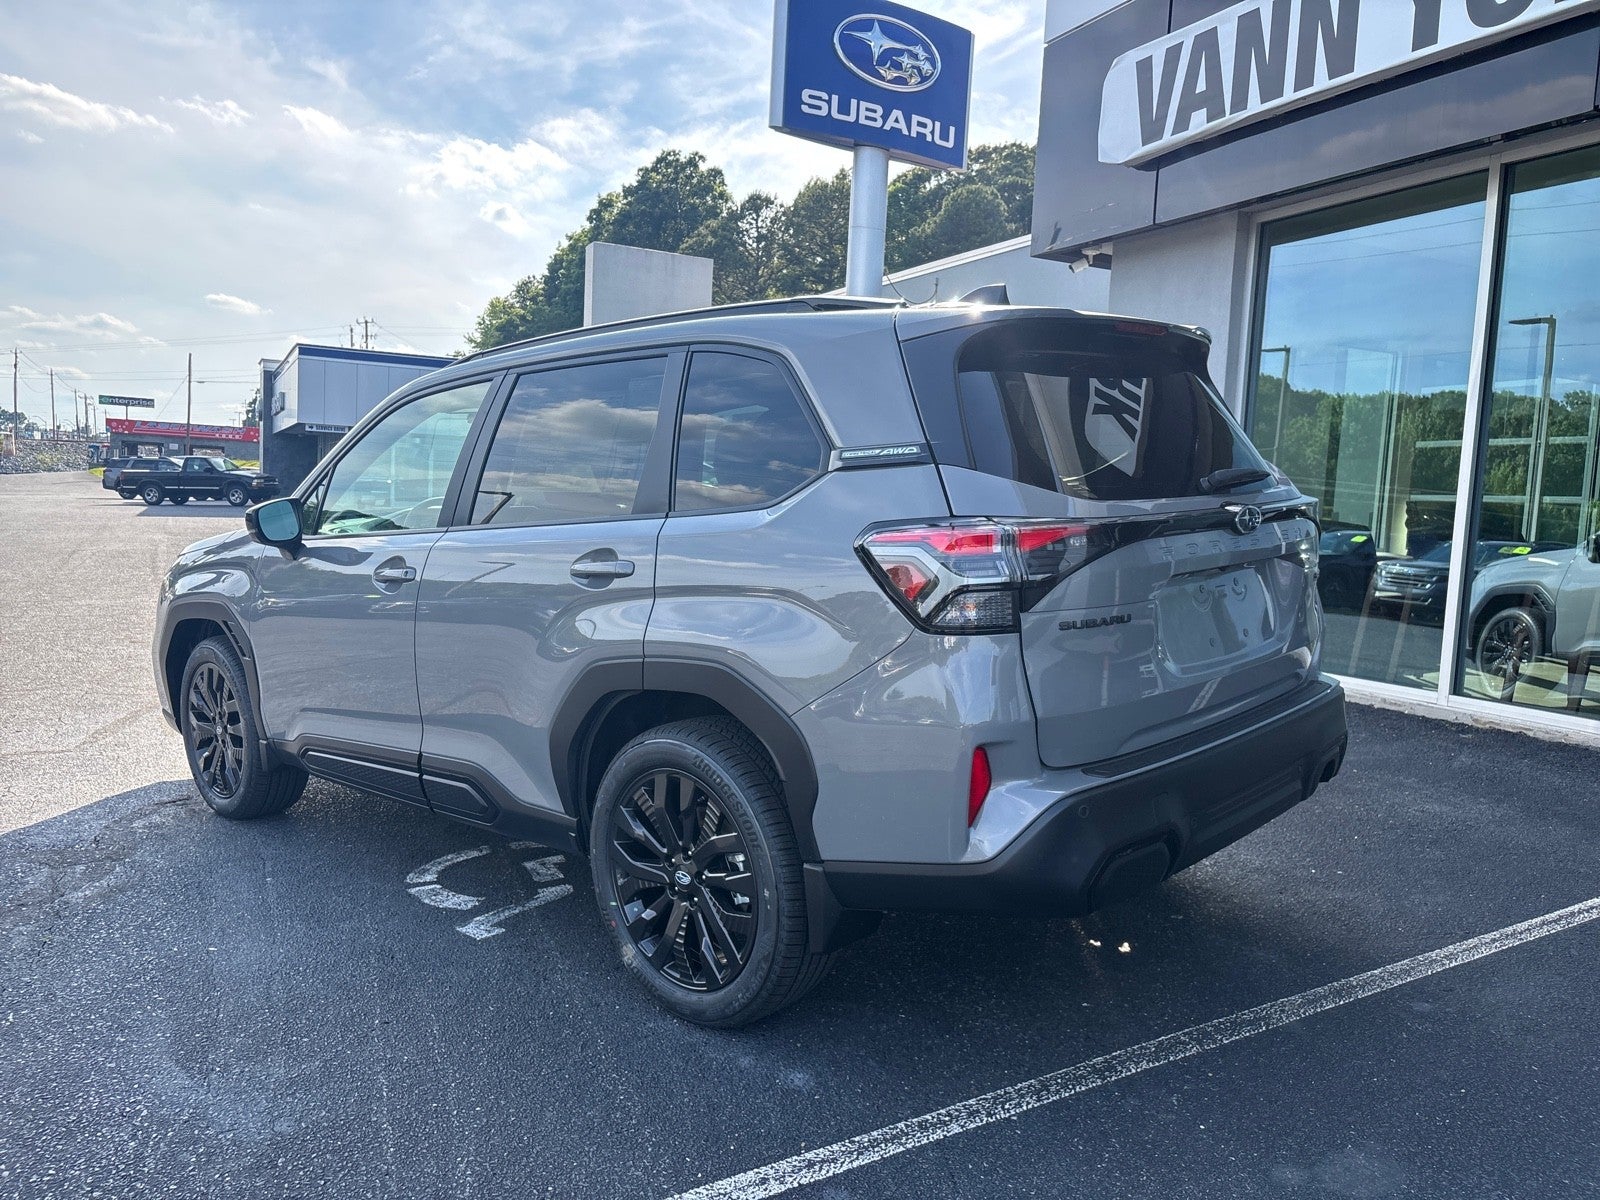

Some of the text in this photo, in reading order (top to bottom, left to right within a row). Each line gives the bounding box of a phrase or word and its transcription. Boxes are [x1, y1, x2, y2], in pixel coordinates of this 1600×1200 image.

[1135, 0, 1360, 146] VANN
[800, 88, 956, 149] SUBARU
[100, 396, 154, 406] enterprise
[879, 446, 917, 456] AWD
[1058, 613, 1132, 631] SUBARU
[691, 753, 764, 855] BRIDGESTONE
